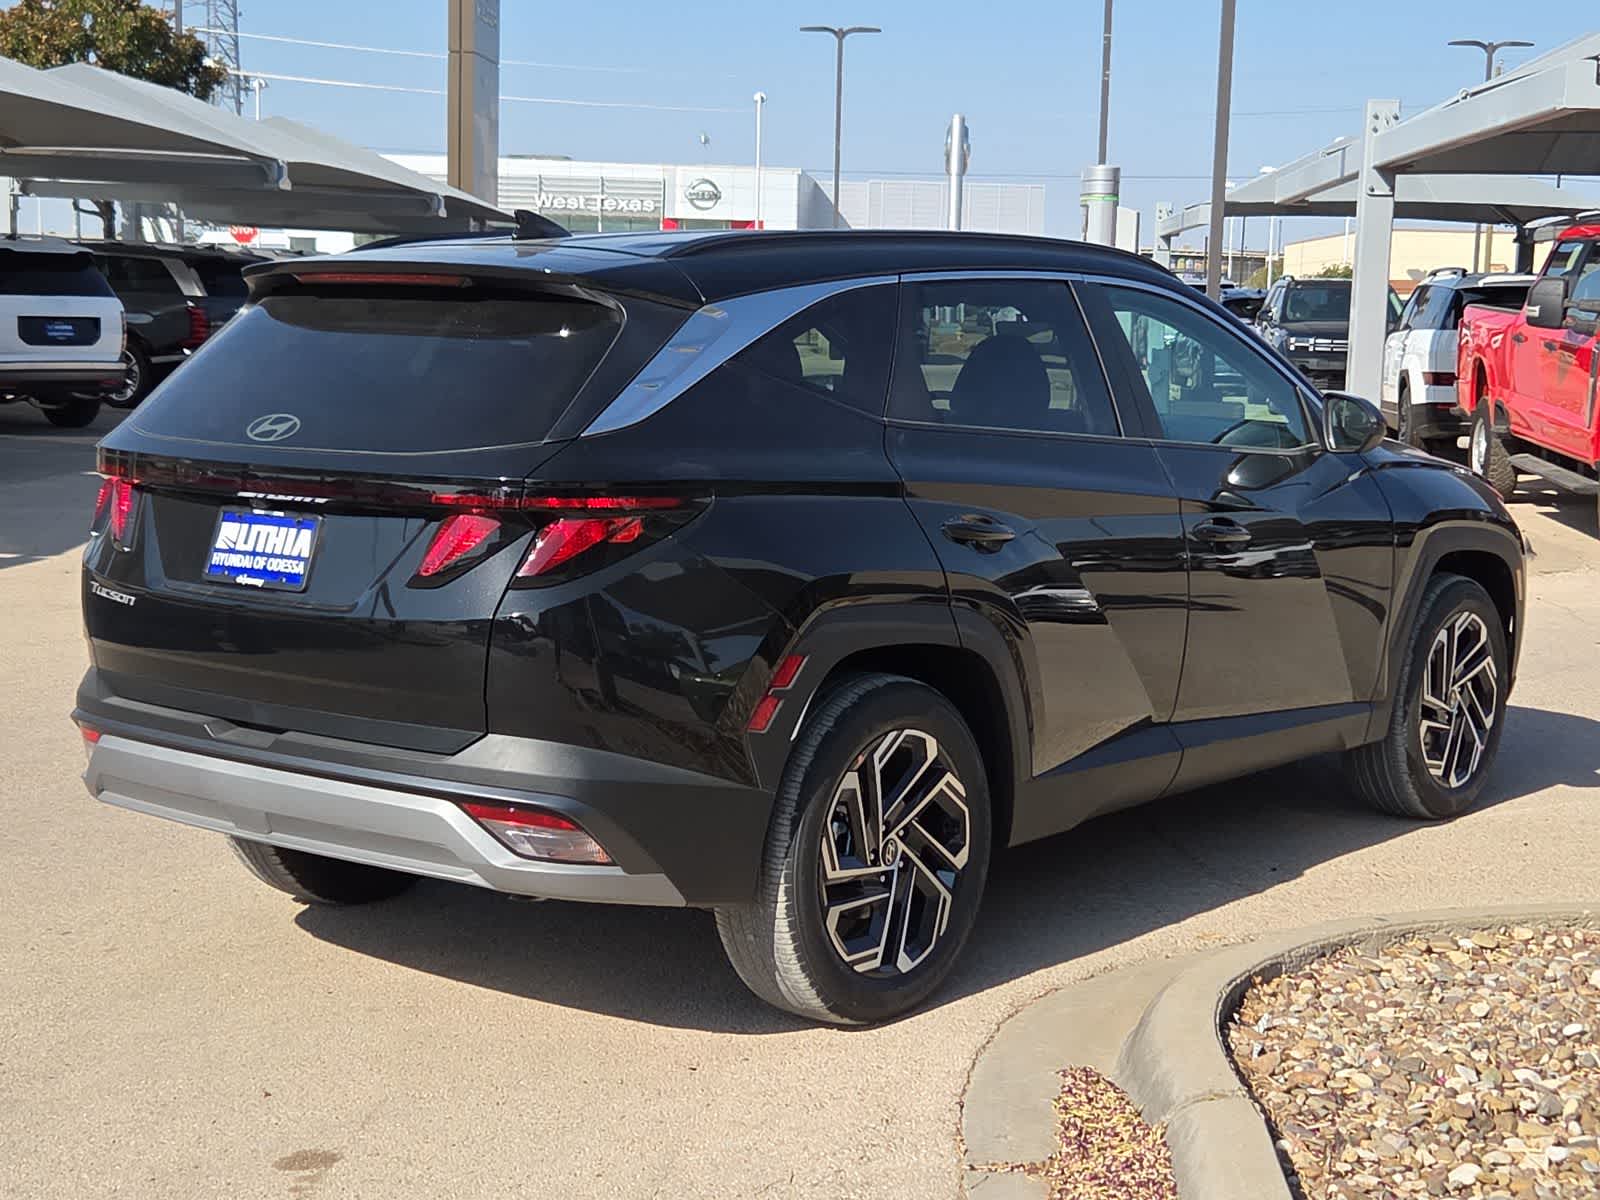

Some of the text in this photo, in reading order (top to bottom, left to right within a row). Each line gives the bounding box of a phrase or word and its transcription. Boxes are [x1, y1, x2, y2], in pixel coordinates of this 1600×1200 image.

[534, 192, 656, 212] West Texas
[235, 522, 312, 558] LITHIA
[211, 551, 305, 575] HYUNDAI OF ODESSA
